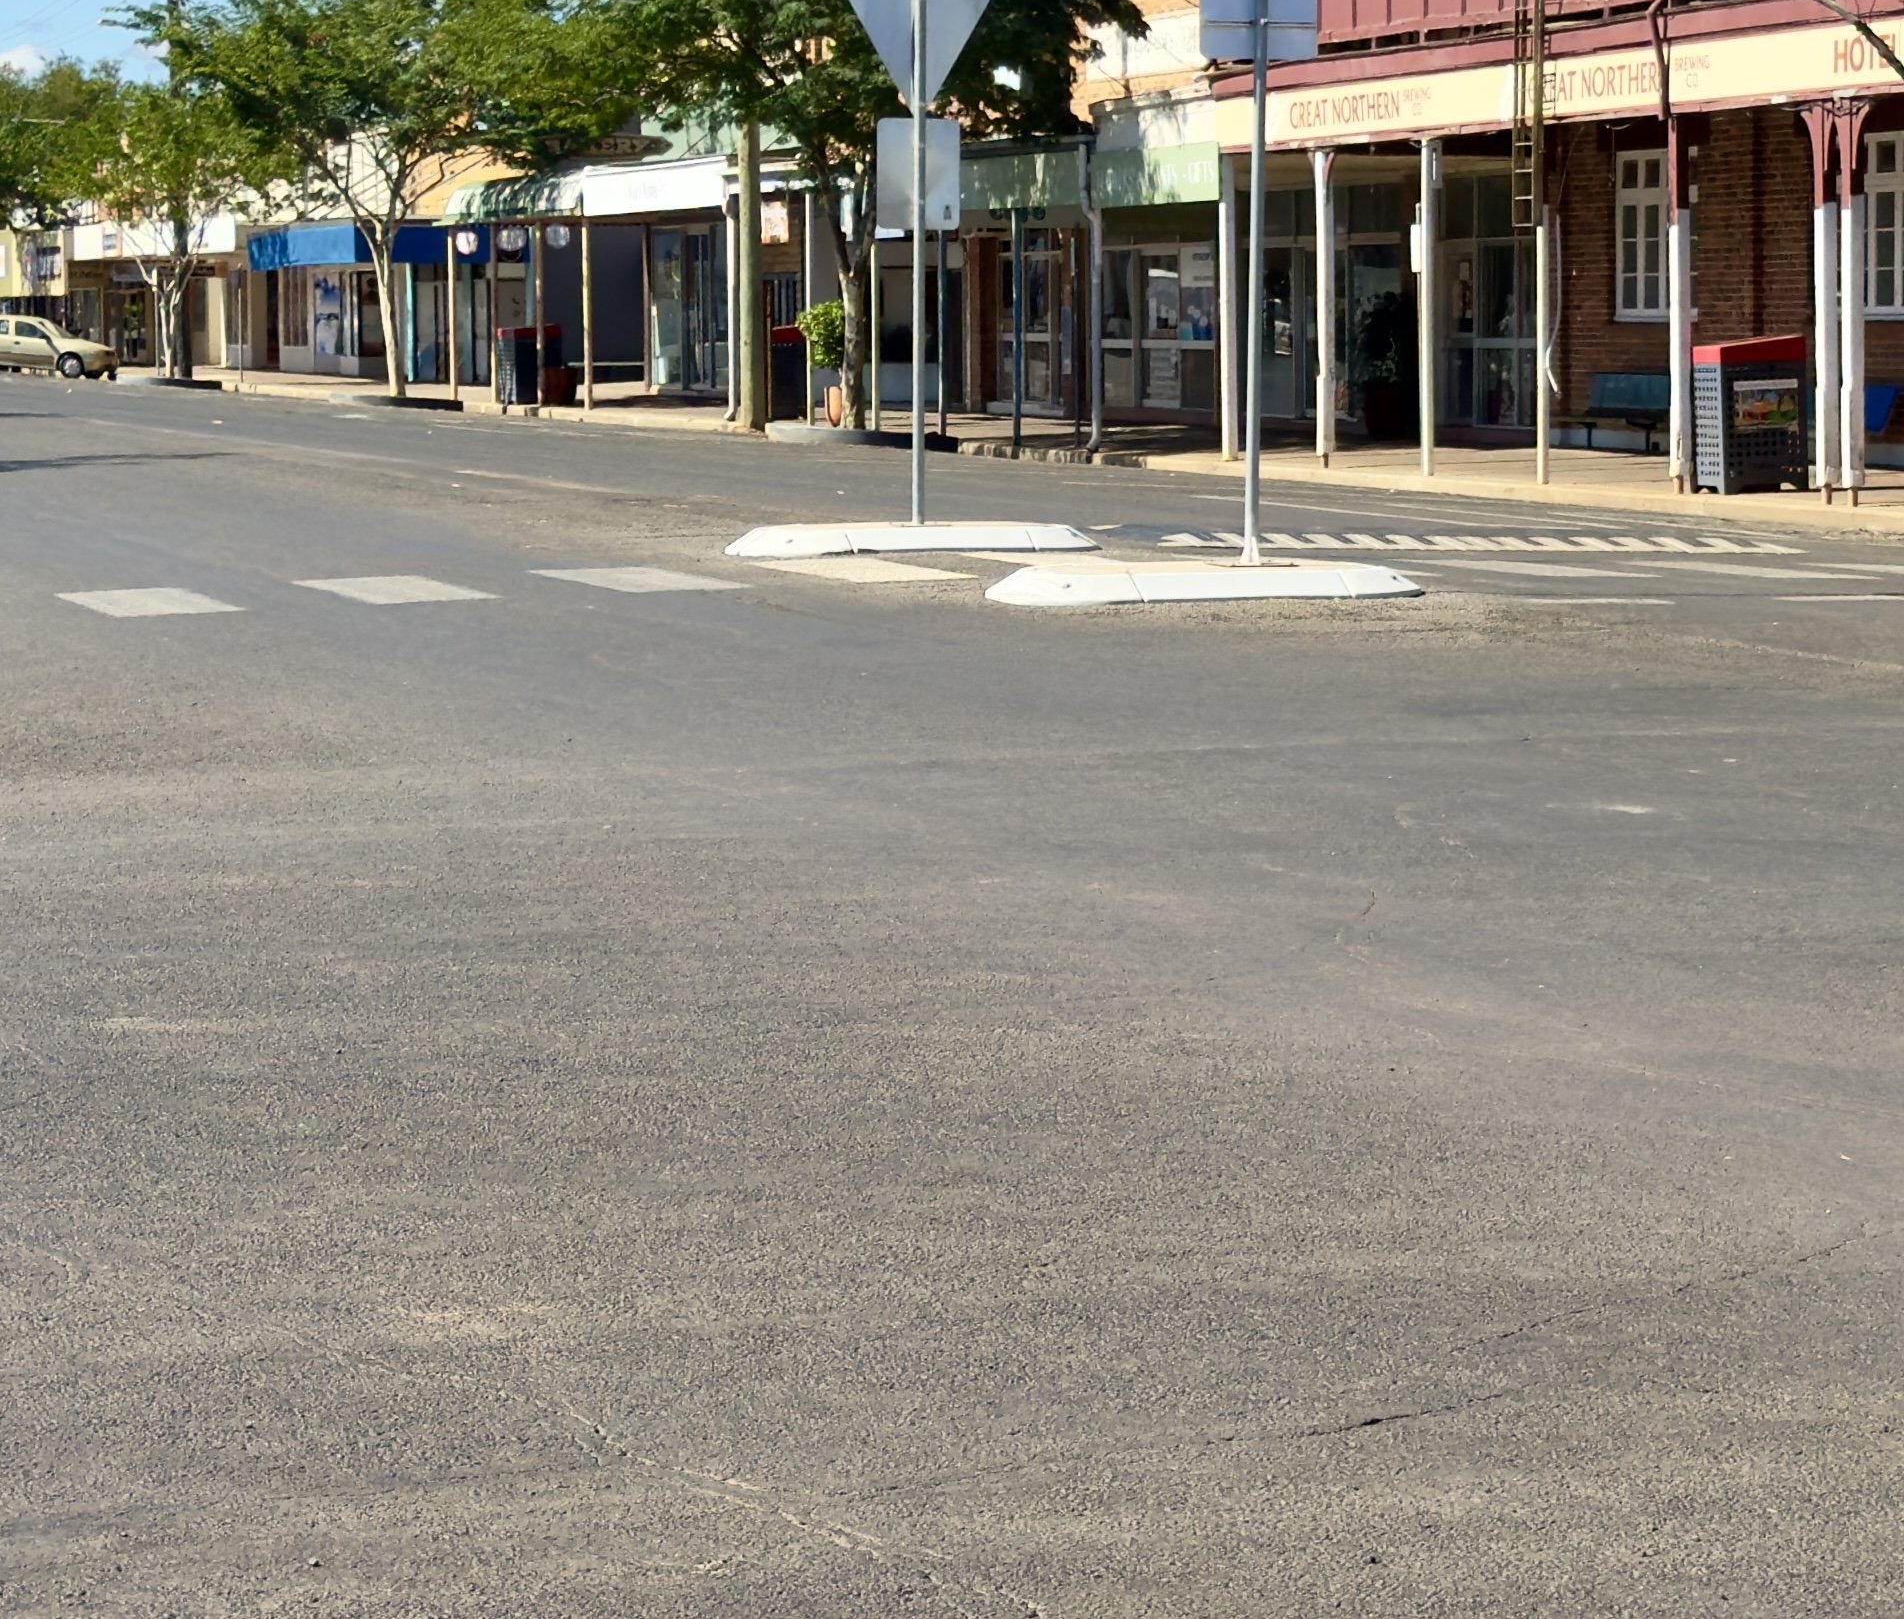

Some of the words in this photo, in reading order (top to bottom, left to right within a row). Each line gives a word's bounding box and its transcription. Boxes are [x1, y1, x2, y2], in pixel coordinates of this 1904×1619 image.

[1581, 61, 1664, 99] NORTHER
[1674, 54, 1711, 72] BREWING
[1289, 98, 1328, 129] GREAT
[1332, 91, 1400, 125] NORTHERN
